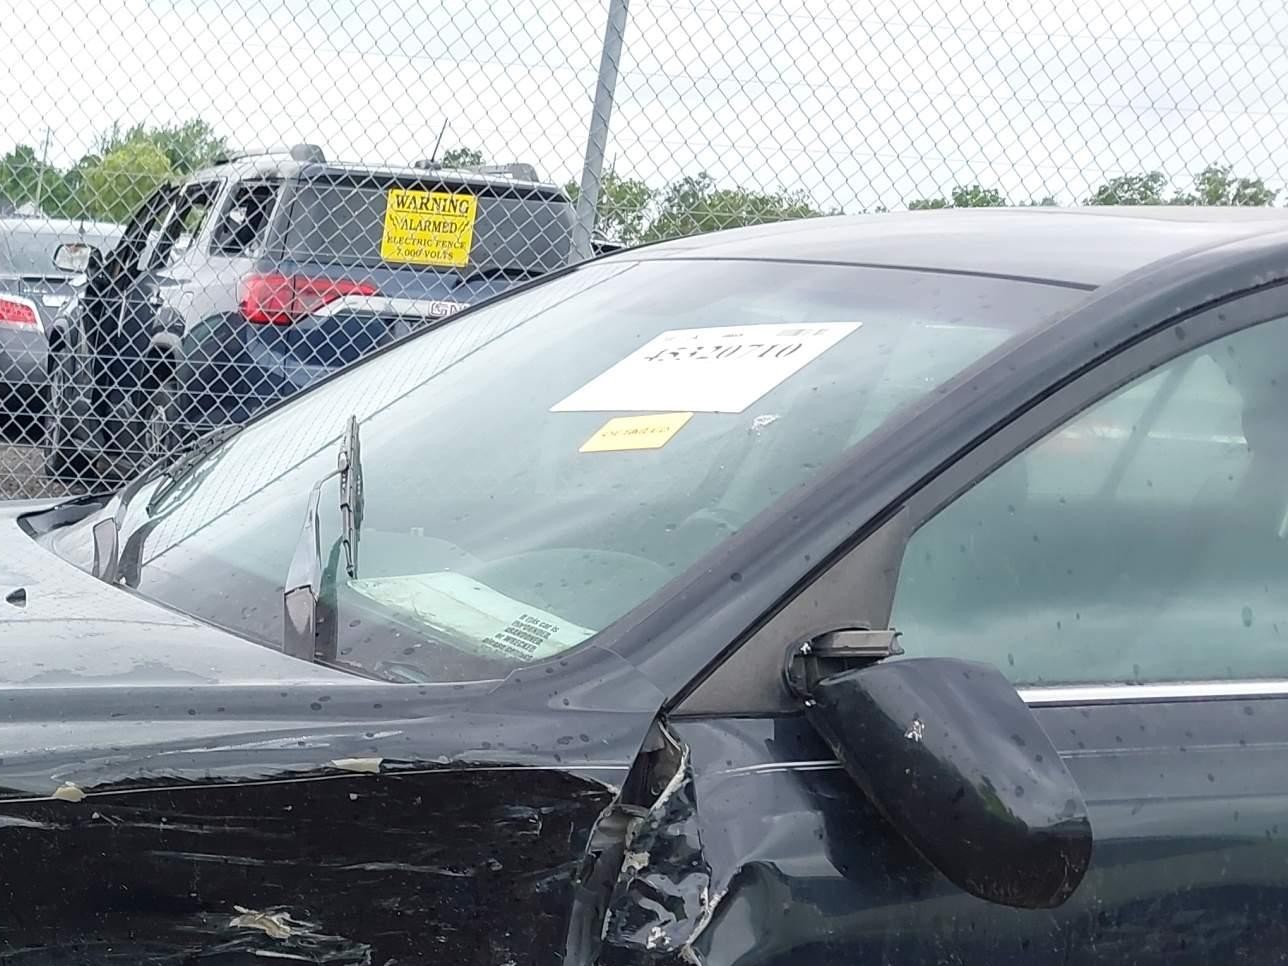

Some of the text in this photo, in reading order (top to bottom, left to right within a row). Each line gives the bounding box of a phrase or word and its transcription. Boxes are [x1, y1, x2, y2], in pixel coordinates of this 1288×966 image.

[395, 193, 470, 214] WARNING
[399, 218, 458, 234] ALARMED
[386, 233, 467, 250] ELECTRIC FENCE
[423, 249, 453, 261] VOLTS
